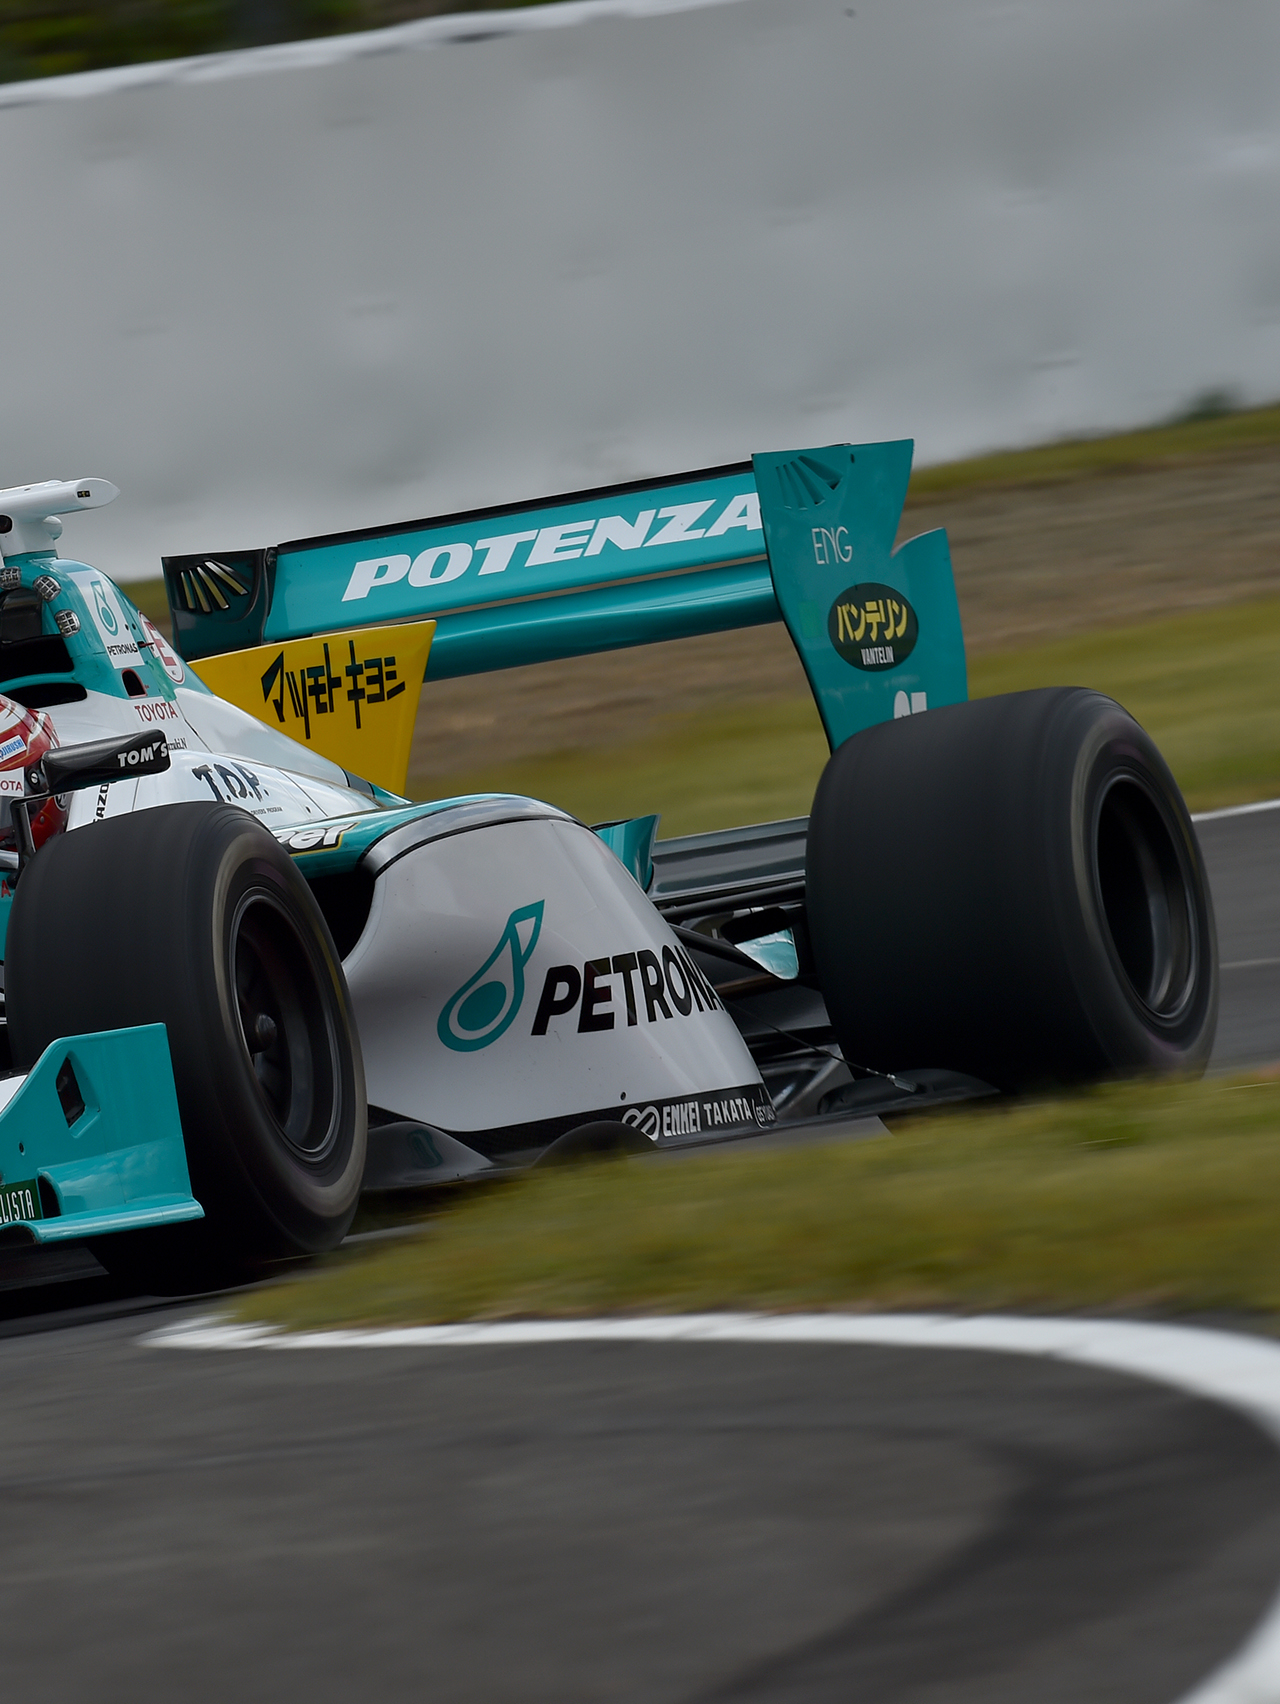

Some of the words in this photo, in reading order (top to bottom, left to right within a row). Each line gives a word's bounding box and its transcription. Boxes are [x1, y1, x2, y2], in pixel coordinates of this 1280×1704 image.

[341, 491, 763, 602] POTENZA
[836, 598, 908, 643] バンテリン
[107, 643, 138, 656] PETRONAS
[860, 646, 895, 666] VANTELIN
[134, 701, 179, 723] TOYOTA
[117, 741, 169, 768] TOM'S
[192, 761, 270, 803] T.D.P.
[662, 1101, 702, 1137] ENKEI
[703, 1097, 753, 1126] TAKATA
